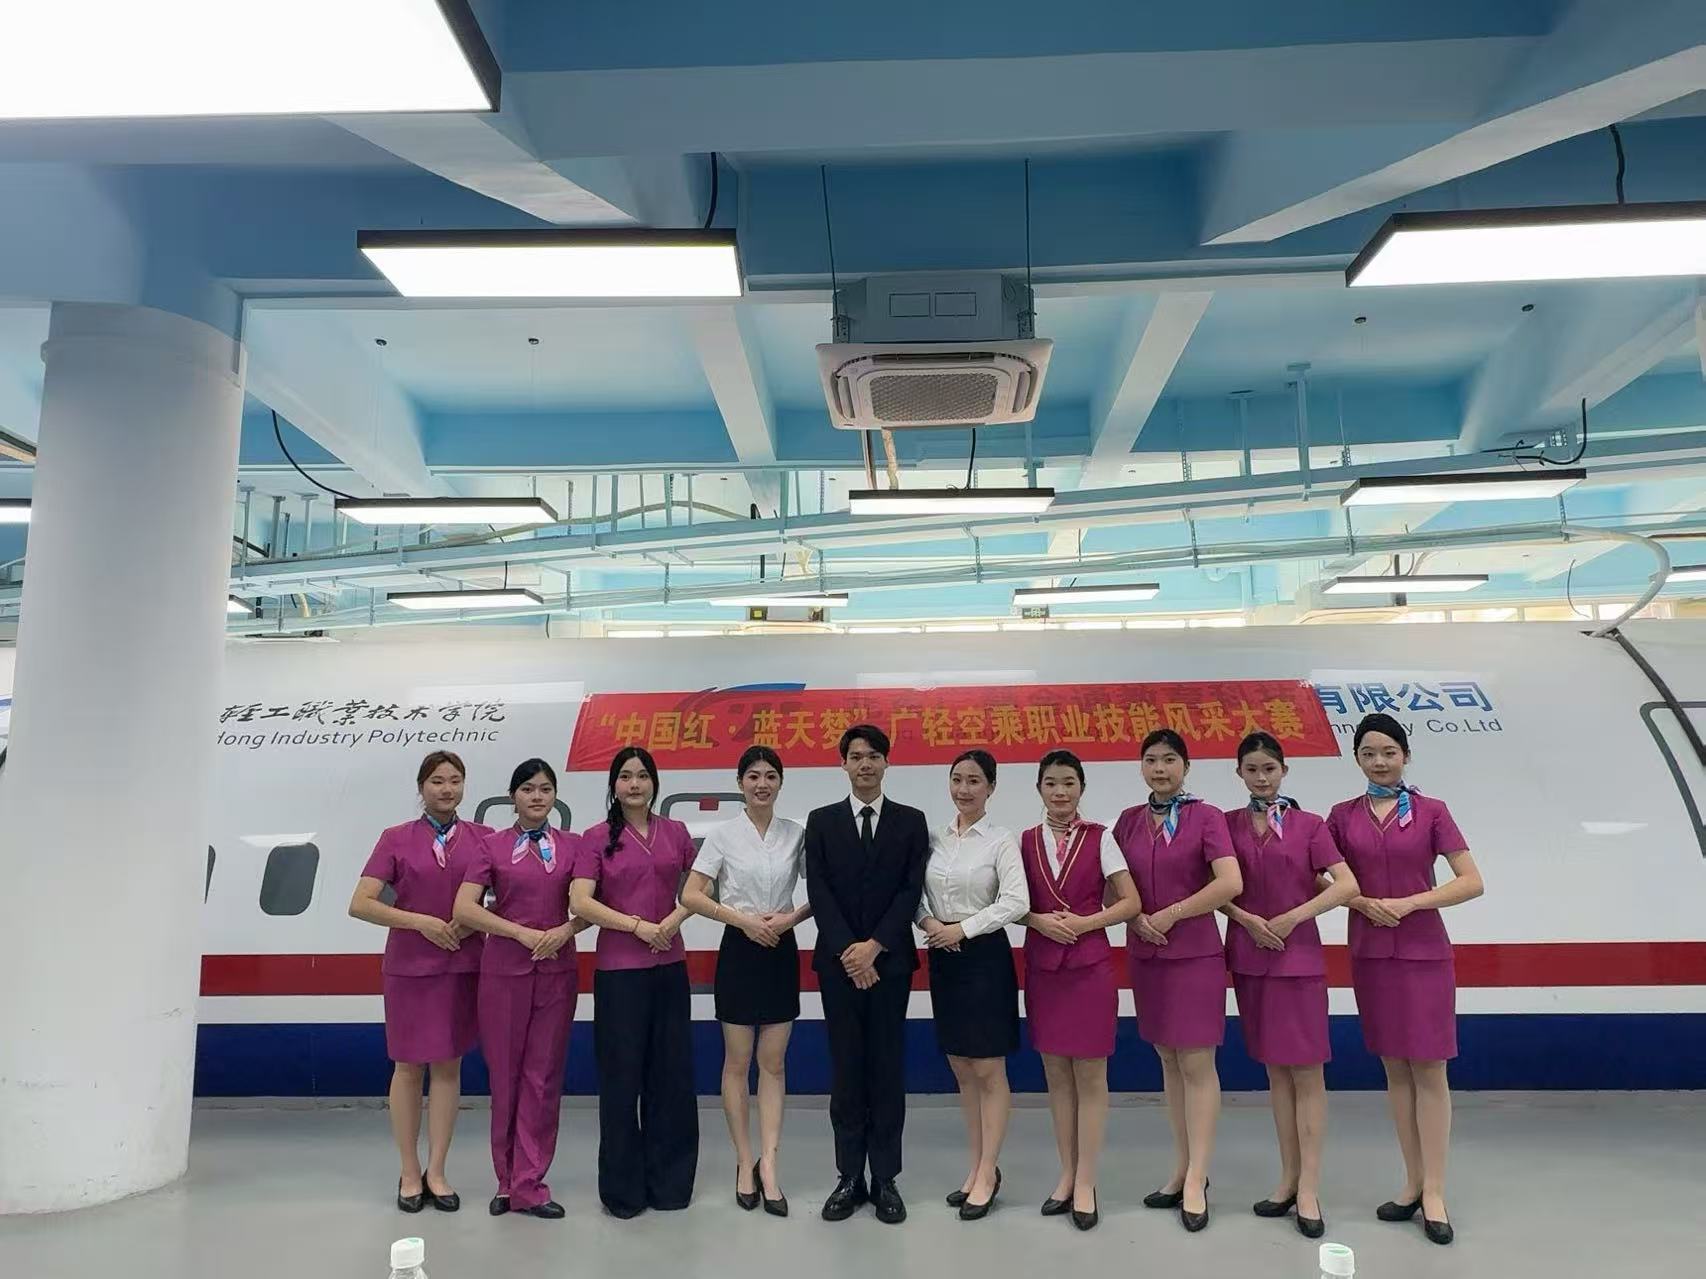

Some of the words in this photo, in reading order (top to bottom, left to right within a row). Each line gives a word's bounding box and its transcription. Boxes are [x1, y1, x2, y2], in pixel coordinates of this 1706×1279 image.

[1314, 680, 1494, 714] 有限公司
[270, 730, 363, 748] Industry
[368, 727, 500, 747] Polytechnic
